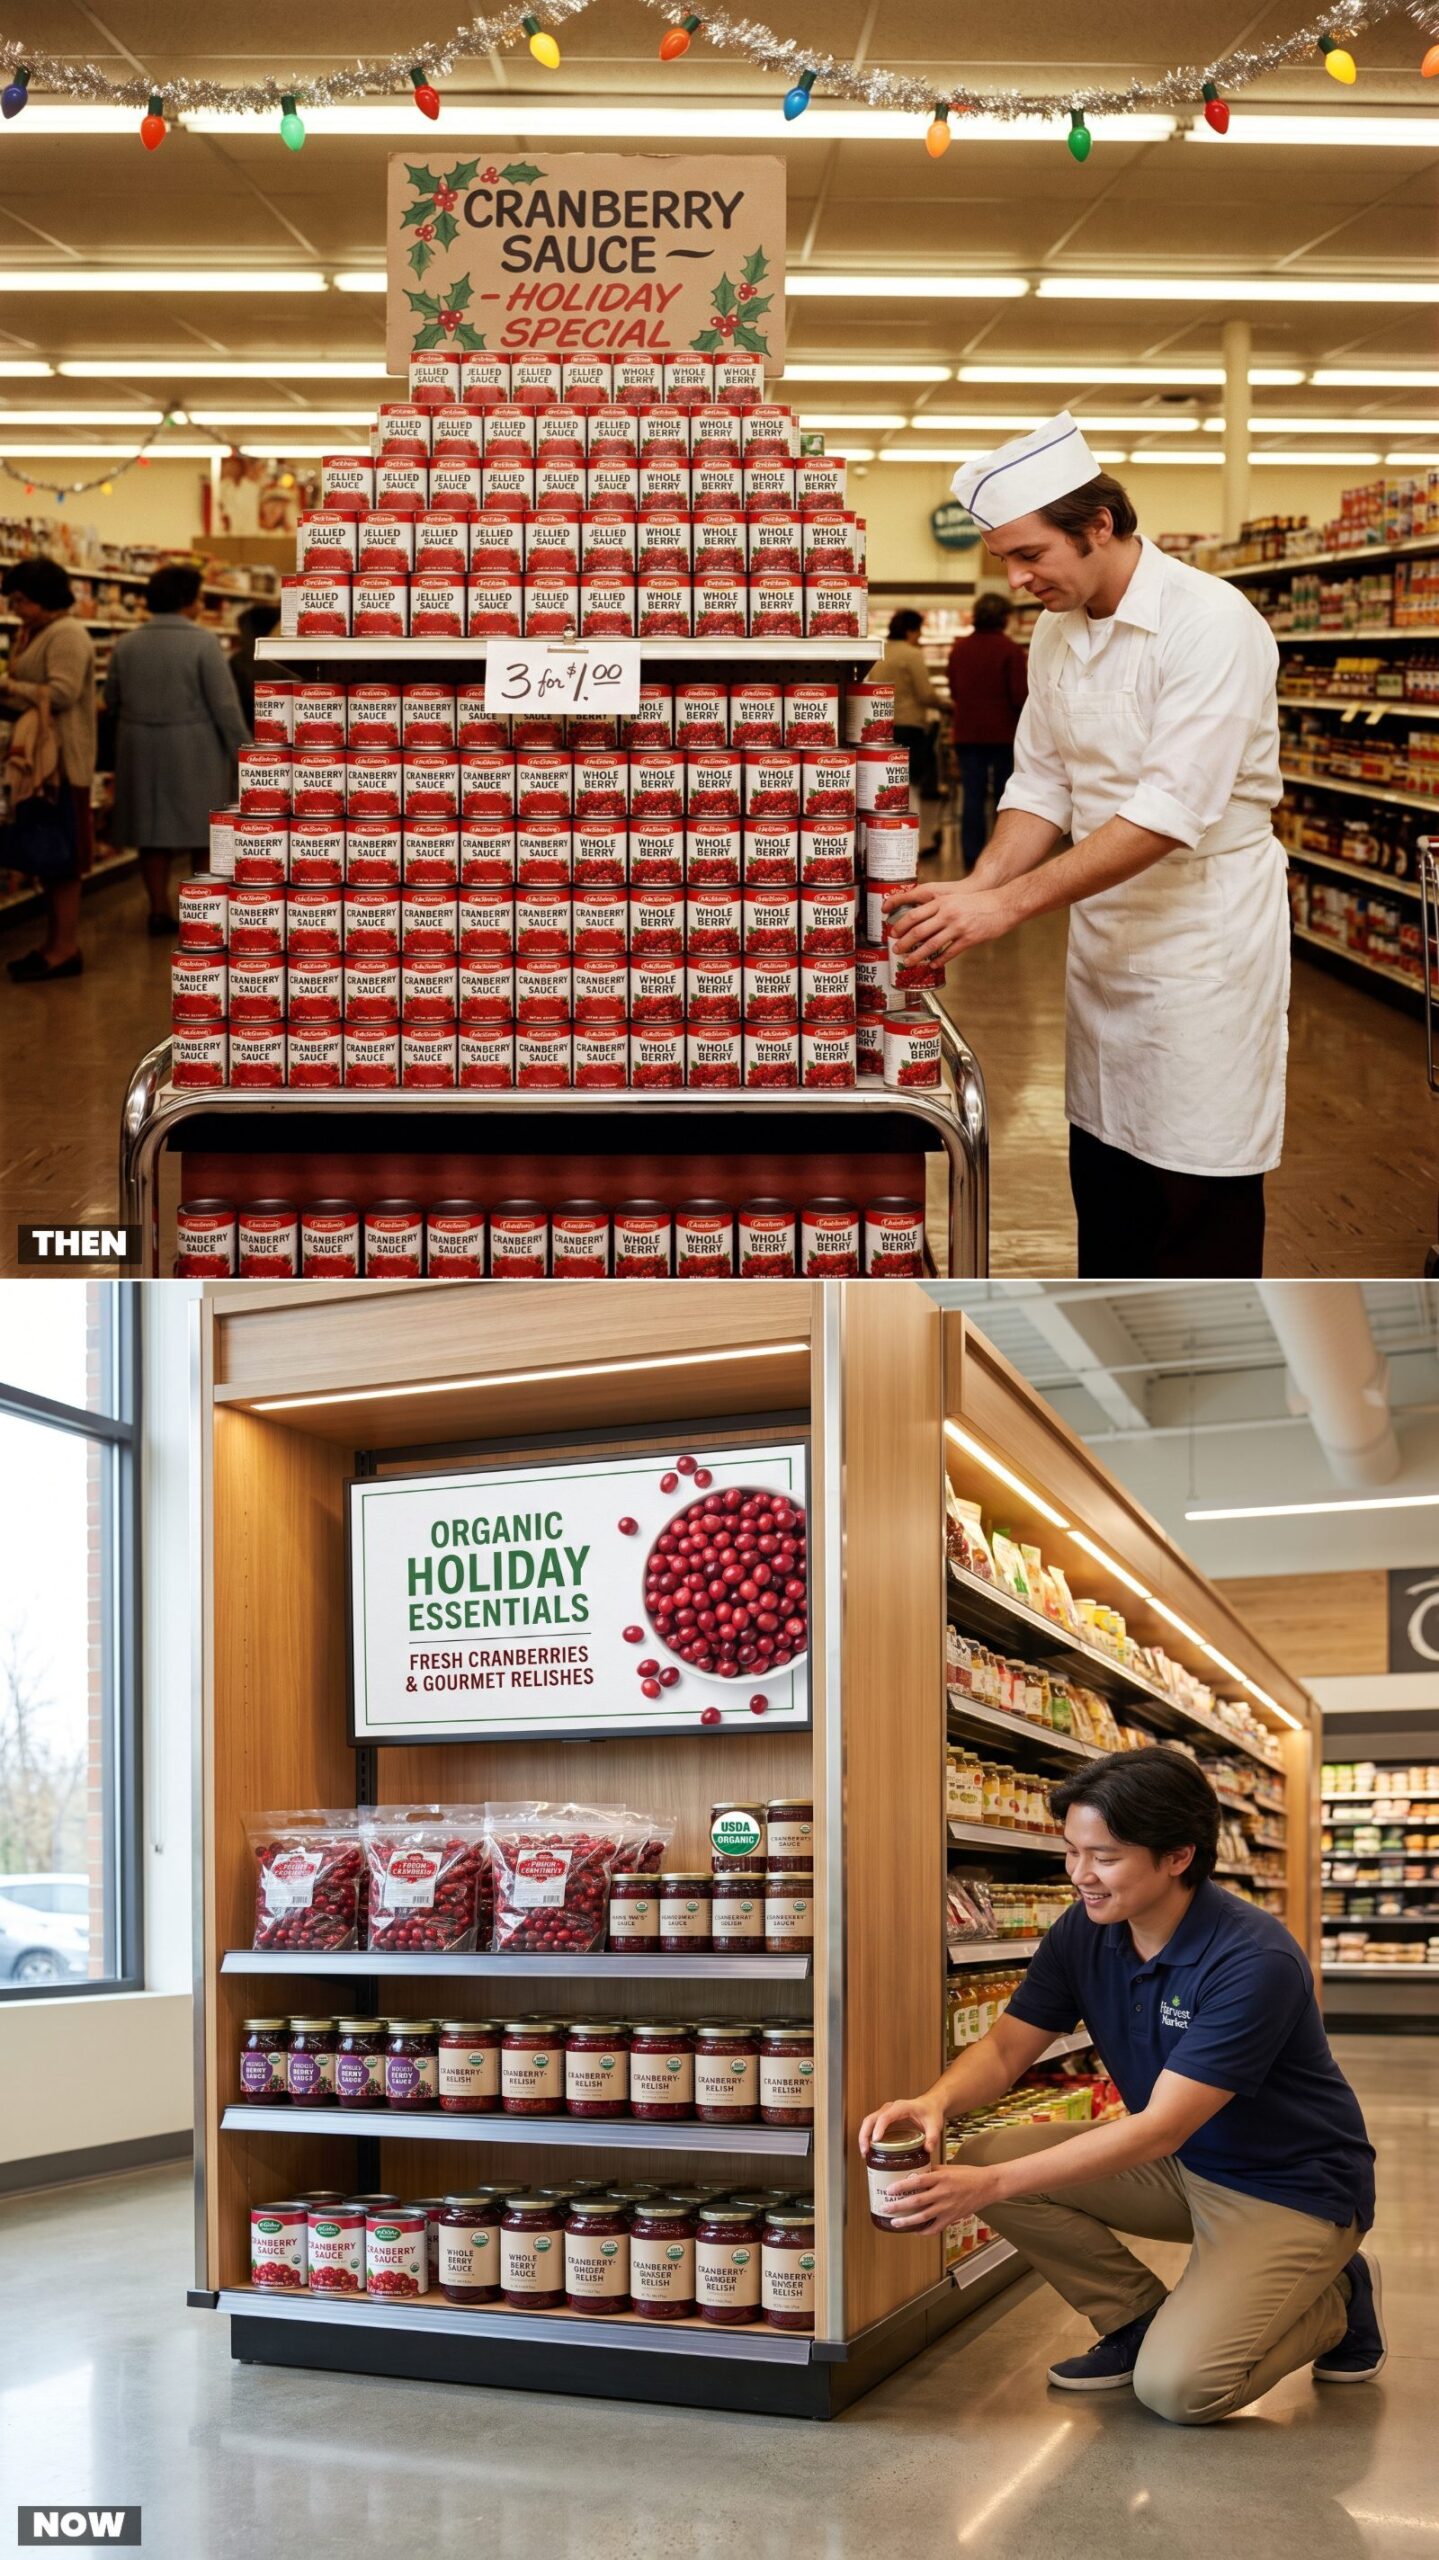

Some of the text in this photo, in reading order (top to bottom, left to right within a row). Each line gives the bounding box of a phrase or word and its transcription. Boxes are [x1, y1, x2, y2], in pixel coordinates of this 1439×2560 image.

[463, 189, 745, 230] CRANBERRY
[500, 234, 657, 274] SAUCE
[505, 282, 684, 312] HOLIDAY
[500, 317, 671, 348] SPECIAL
[414, 368, 449, 376] JELLIED
[517, 368, 552, 376] JELLIED
[724, 368, 756, 376] WHOLE
[437, 421, 472, 430] JELLIED
[542, 421, 578, 429] JELLIED
[648, 421, 681, 429] WHOLE
[750, 420, 783, 429] WHOLE
[752, 429, 782, 437] BERRY
[326, 473, 364, 481] JELLIED
[434, 474, 471, 482] JELLIED
[647, 474, 681, 482] WHOLE
[751, 473, 785, 481] WHOLE
[648, 482, 680, 490] BERRY
[752, 482, 783, 490] BERRY
[364, 529, 401, 537] JELLIED
[476, 529, 513, 538] JELLIED
[702, 528, 738, 536] WHOLE
[812, 528, 848, 536] WHOLE
[814, 537, 846, 545] BERRY
[300, 592, 338, 601] JELLIED
[416, 593, 454, 602] JELLIED
[646, 592, 682, 600] WHOLE
[758, 592, 794, 600] WHOLE
[420, 602, 449, 610] SAUCE
[648, 601, 680, 609] BERRY
[760, 601, 792, 609] BERRY
[501, 663, 532, 699] 3
[537, 668, 565, 698] for
[684, 702, 720, 711] WHOLE
[793, 703, 828, 712] WHOLE
[412, 712, 441, 720] SAUCE
[686, 711, 718, 720] BERRY
[794, 712, 826, 720] BERRY
[241, 769, 290, 778] CRANBERRY
[348, 771, 397, 780] CRANBERRY
[582, 770, 618, 780] WHOLE
[696, 770, 732, 780] WHOLE
[358, 780, 386, 788] SAUCE
[584, 780, 617, 788] BERRY
[698, 779, 731, 788] BERRY
[292, 839, 340, 848] CRANBERRY
[406, 840, 454, 848] CRANBERRY
[580, 839, 616, 848] WHOLE
[695, 838, 731, 848] WHOLE
[300, 848, 329, 856] SAUCE
[416, 848, 445, 857] SAUCE
[582, 848, 614, 857] BERRY
[697, 847, 730, 856] BERRY
[230, 908, 279, 917] CRANBERRY
[346, 908, 396, 918] CRANBERRY
[639, 908, 675, 918] WHOLE
[754, 908, 790, 917] WHOLE
[238, 918, 267, 926] SAUCE
[356, 918, 385, 927] SAUCE
[641, 918, 674, 927] BERRY
[756, 917, 789, 926] BERRY
[290, 975, 339, 985] CRANBERRY
[404, 976, 453, 985] CRANBERRY
[696, 975, 733, 984] WHOLE
[812, 974, 849, 984] WHOLE
[299, 985, 328, 994] SAUCE
[414, 986, 442, 994] SAUCE
[698, 984, 731, 994] BERRY
[815, 984, 848, 993] BERRY
[232, 1042, 282, 1052] CRANBERRY
[346, 1043, 395, 1053] CRANBERRY
[640, 1043, 676, 1052] WHOLE
[908, 1038, 940, 1050] WHOLE
[241, 1052, 269, 1061] SAUCE
[355, 1054, 384, 1062] SAUCE
[641, 1052, 675, 1062] BERRY
[911, 1048, 940, 1059] BERRY
[240, 1233, 290, 1244] CRANBERRY
[368, 1233, 417, 1244] CRANBERRY
[686, 1234, 723, 1244] WHOLE
[815, 1232, 852, 1242] WHOLE
[248, 1244, 278, 1254] SAUCE
[376, 1244, 406, 1254] SAUCE
[688, 1244, 722, 1254] BERRY
[817, 1242, 850, 1252] BERRY
[430, 1511, 563, 1548] ORGANIC
[407, 1545, 590, 1597] HOLIDAY
[408, 1593, 589, 1632] ESSENTIALS
[410, 1645, 589, 1671] FRESH CRANBERRIES
[405, 1667, 594, 1693] & GOURMET RELISHES
[720, 1822, 750, 1832] USDA
[717, 1835, 754, 1844] ORGANIC
[1160, 2000, 1191, 2020] Harvest
[1161, 2014, 1188, 2029] Market
[258, 2247, 286, 2255] SAUCE
[446, 2248, 474, 2257] WHOLE
[374, 2255, 403, 2264] SAUCE
[509, 2254, 538, 2262] WHOLE
[448, 2264, 472, 2272] SAUCE
[510, 2269, 536, 2277] SAUCE
[641, 2278, 670, 2286] RELISH
[706, 2283, 736, 2292] RELISH
